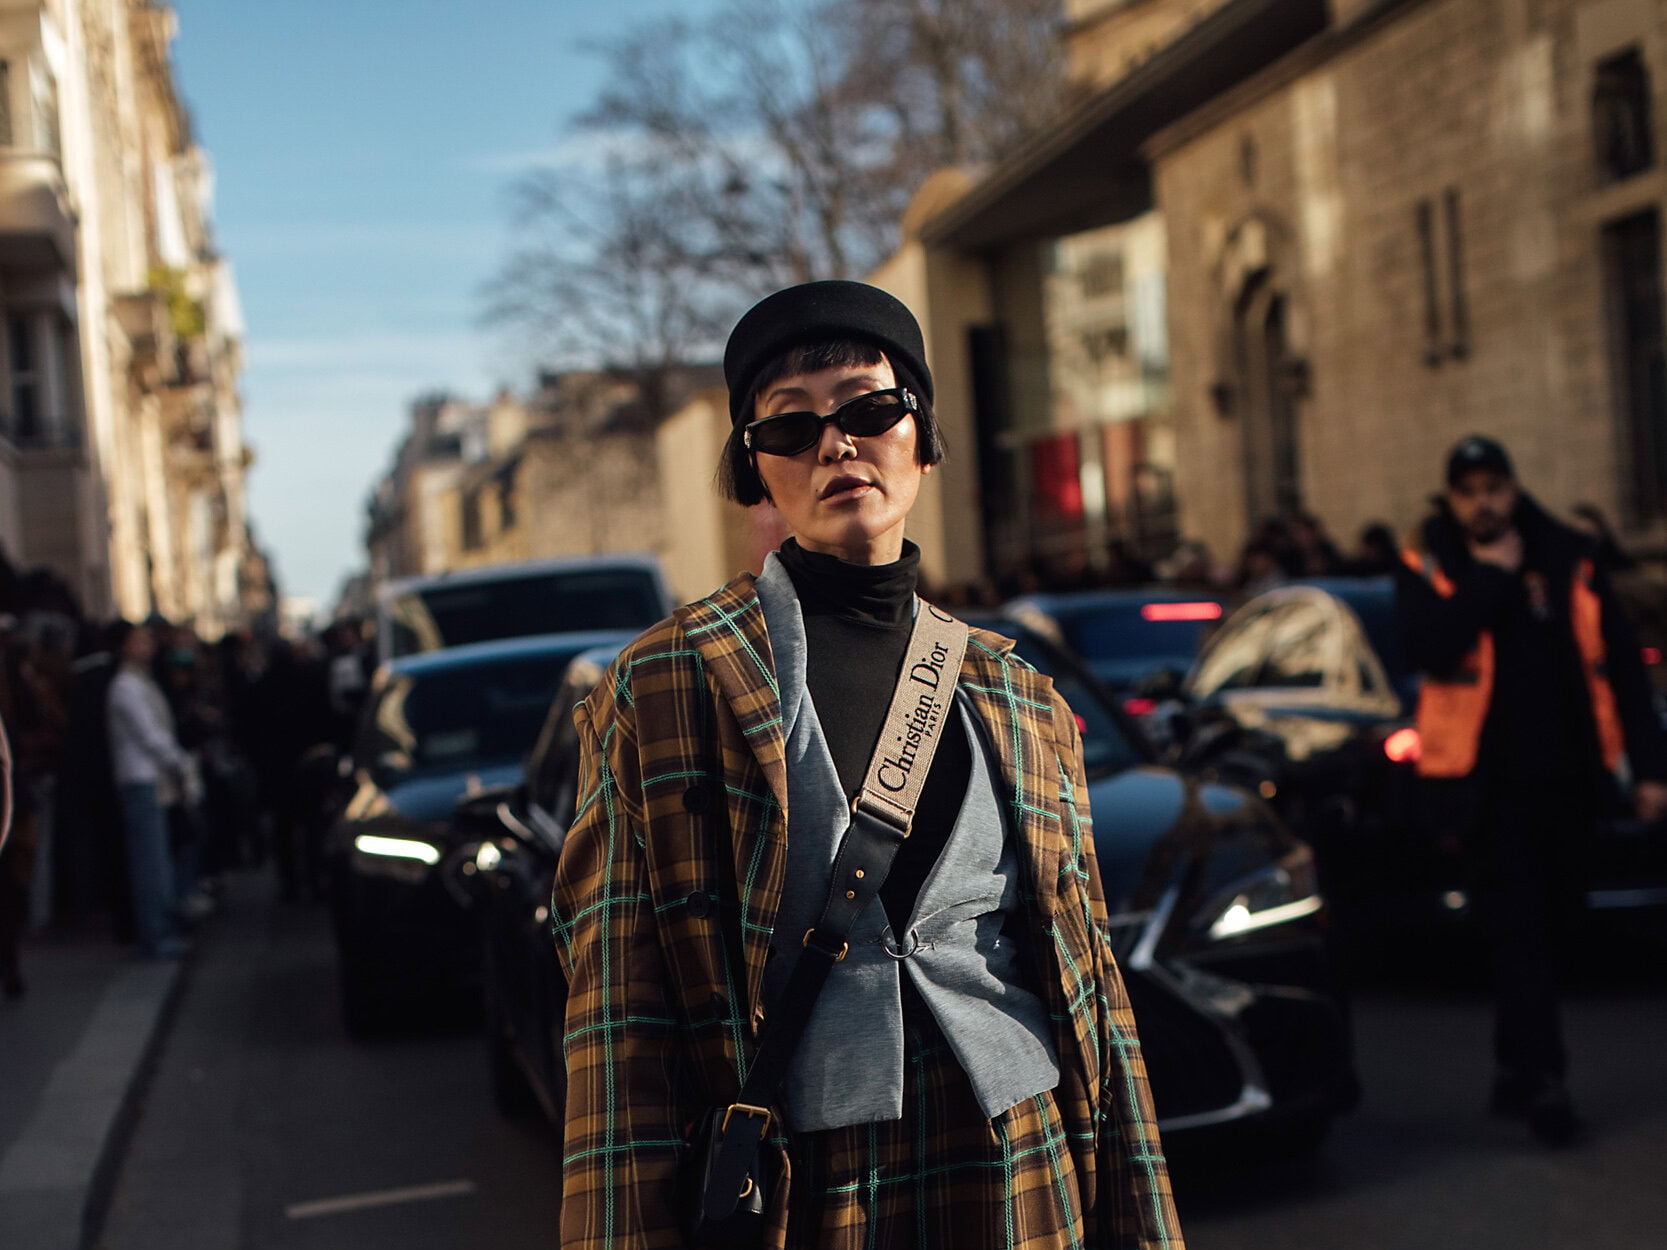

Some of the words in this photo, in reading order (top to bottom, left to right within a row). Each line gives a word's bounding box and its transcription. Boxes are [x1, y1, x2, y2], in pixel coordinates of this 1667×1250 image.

[877, 693, 934, 793] Christian
[909, 641, 949, 692] Dior
[925, 702, 942, 738] PARIS
